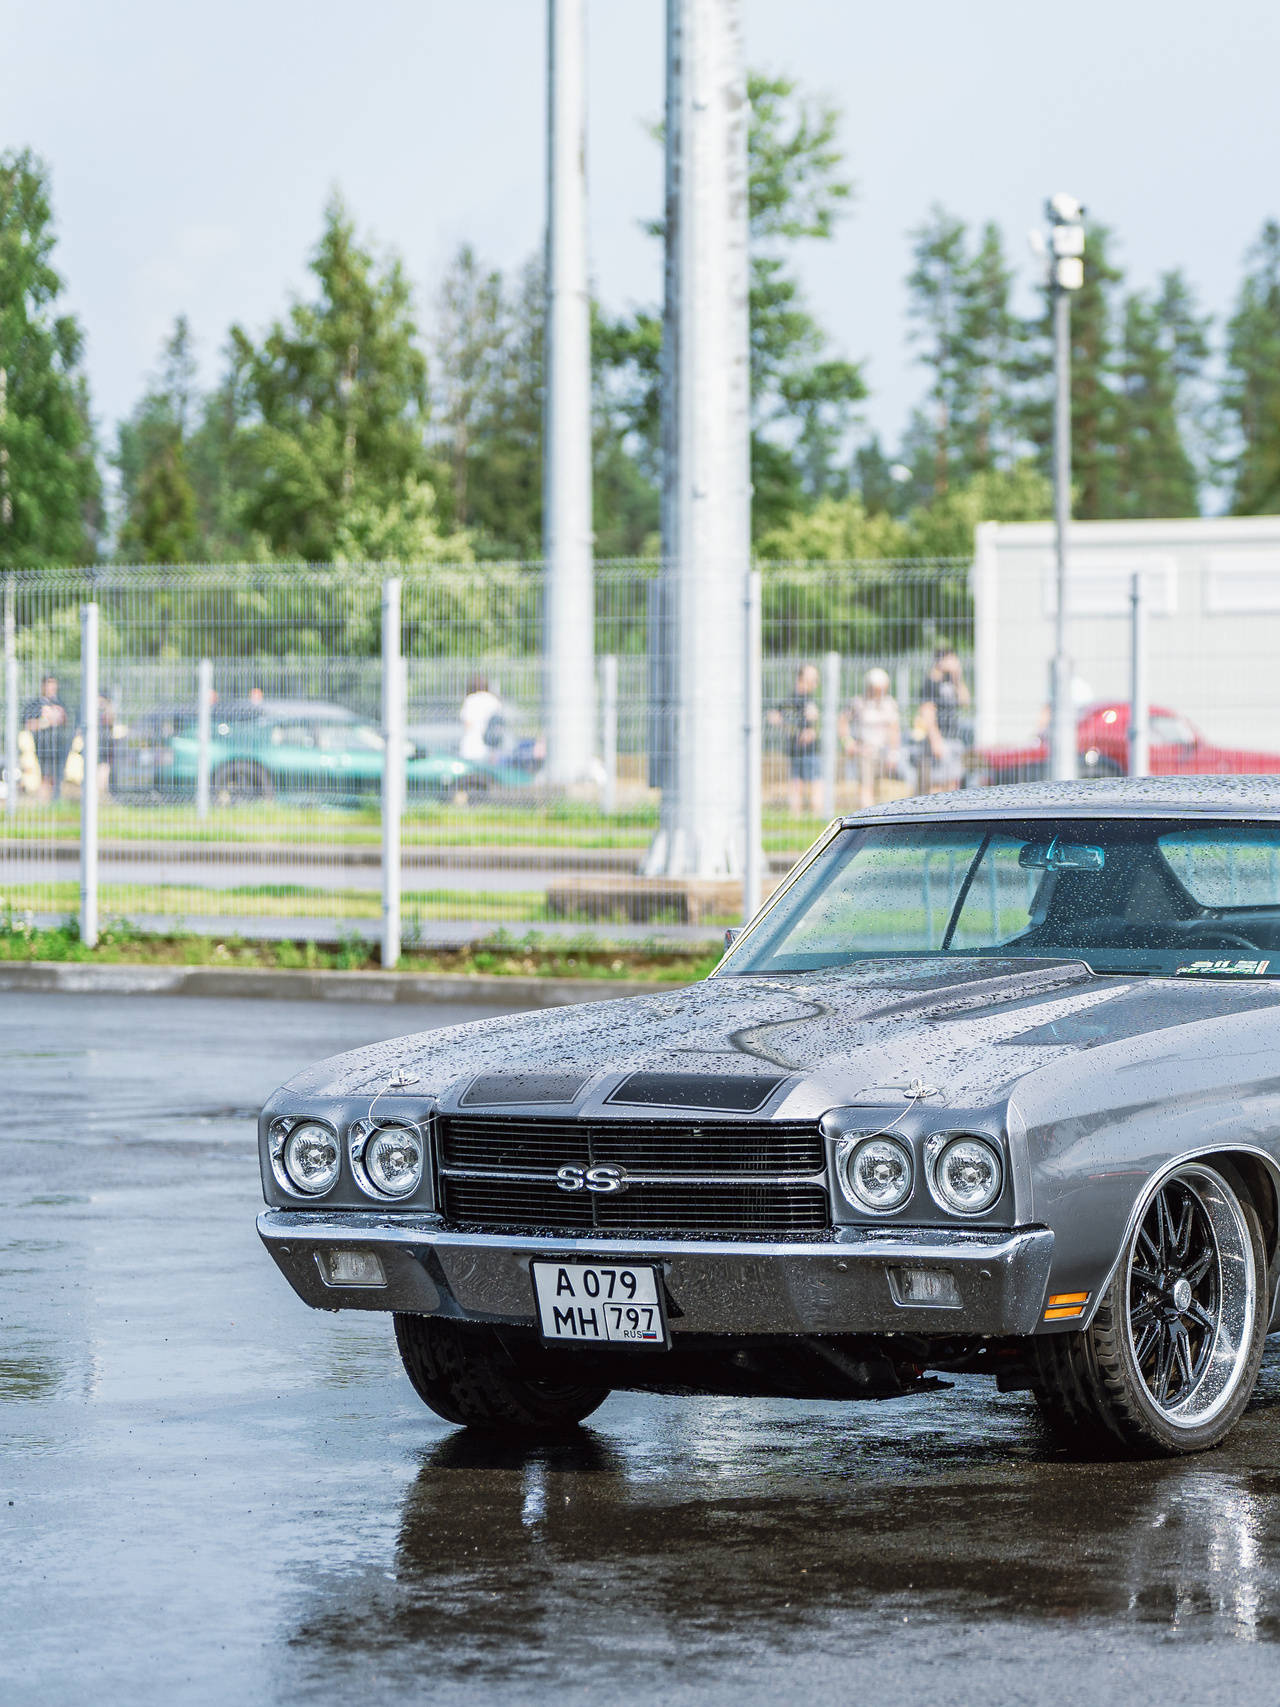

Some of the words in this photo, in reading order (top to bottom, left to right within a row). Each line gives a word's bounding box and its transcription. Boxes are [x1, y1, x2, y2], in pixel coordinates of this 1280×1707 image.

[556, 1165, 621, 1191] SS
[583, 1269, 637, 1299] 079
[553, 1306, 600, 1337] MH
[610, 1307, 654, 1331] 797
[623, 1330, 643, 1338] RUS
